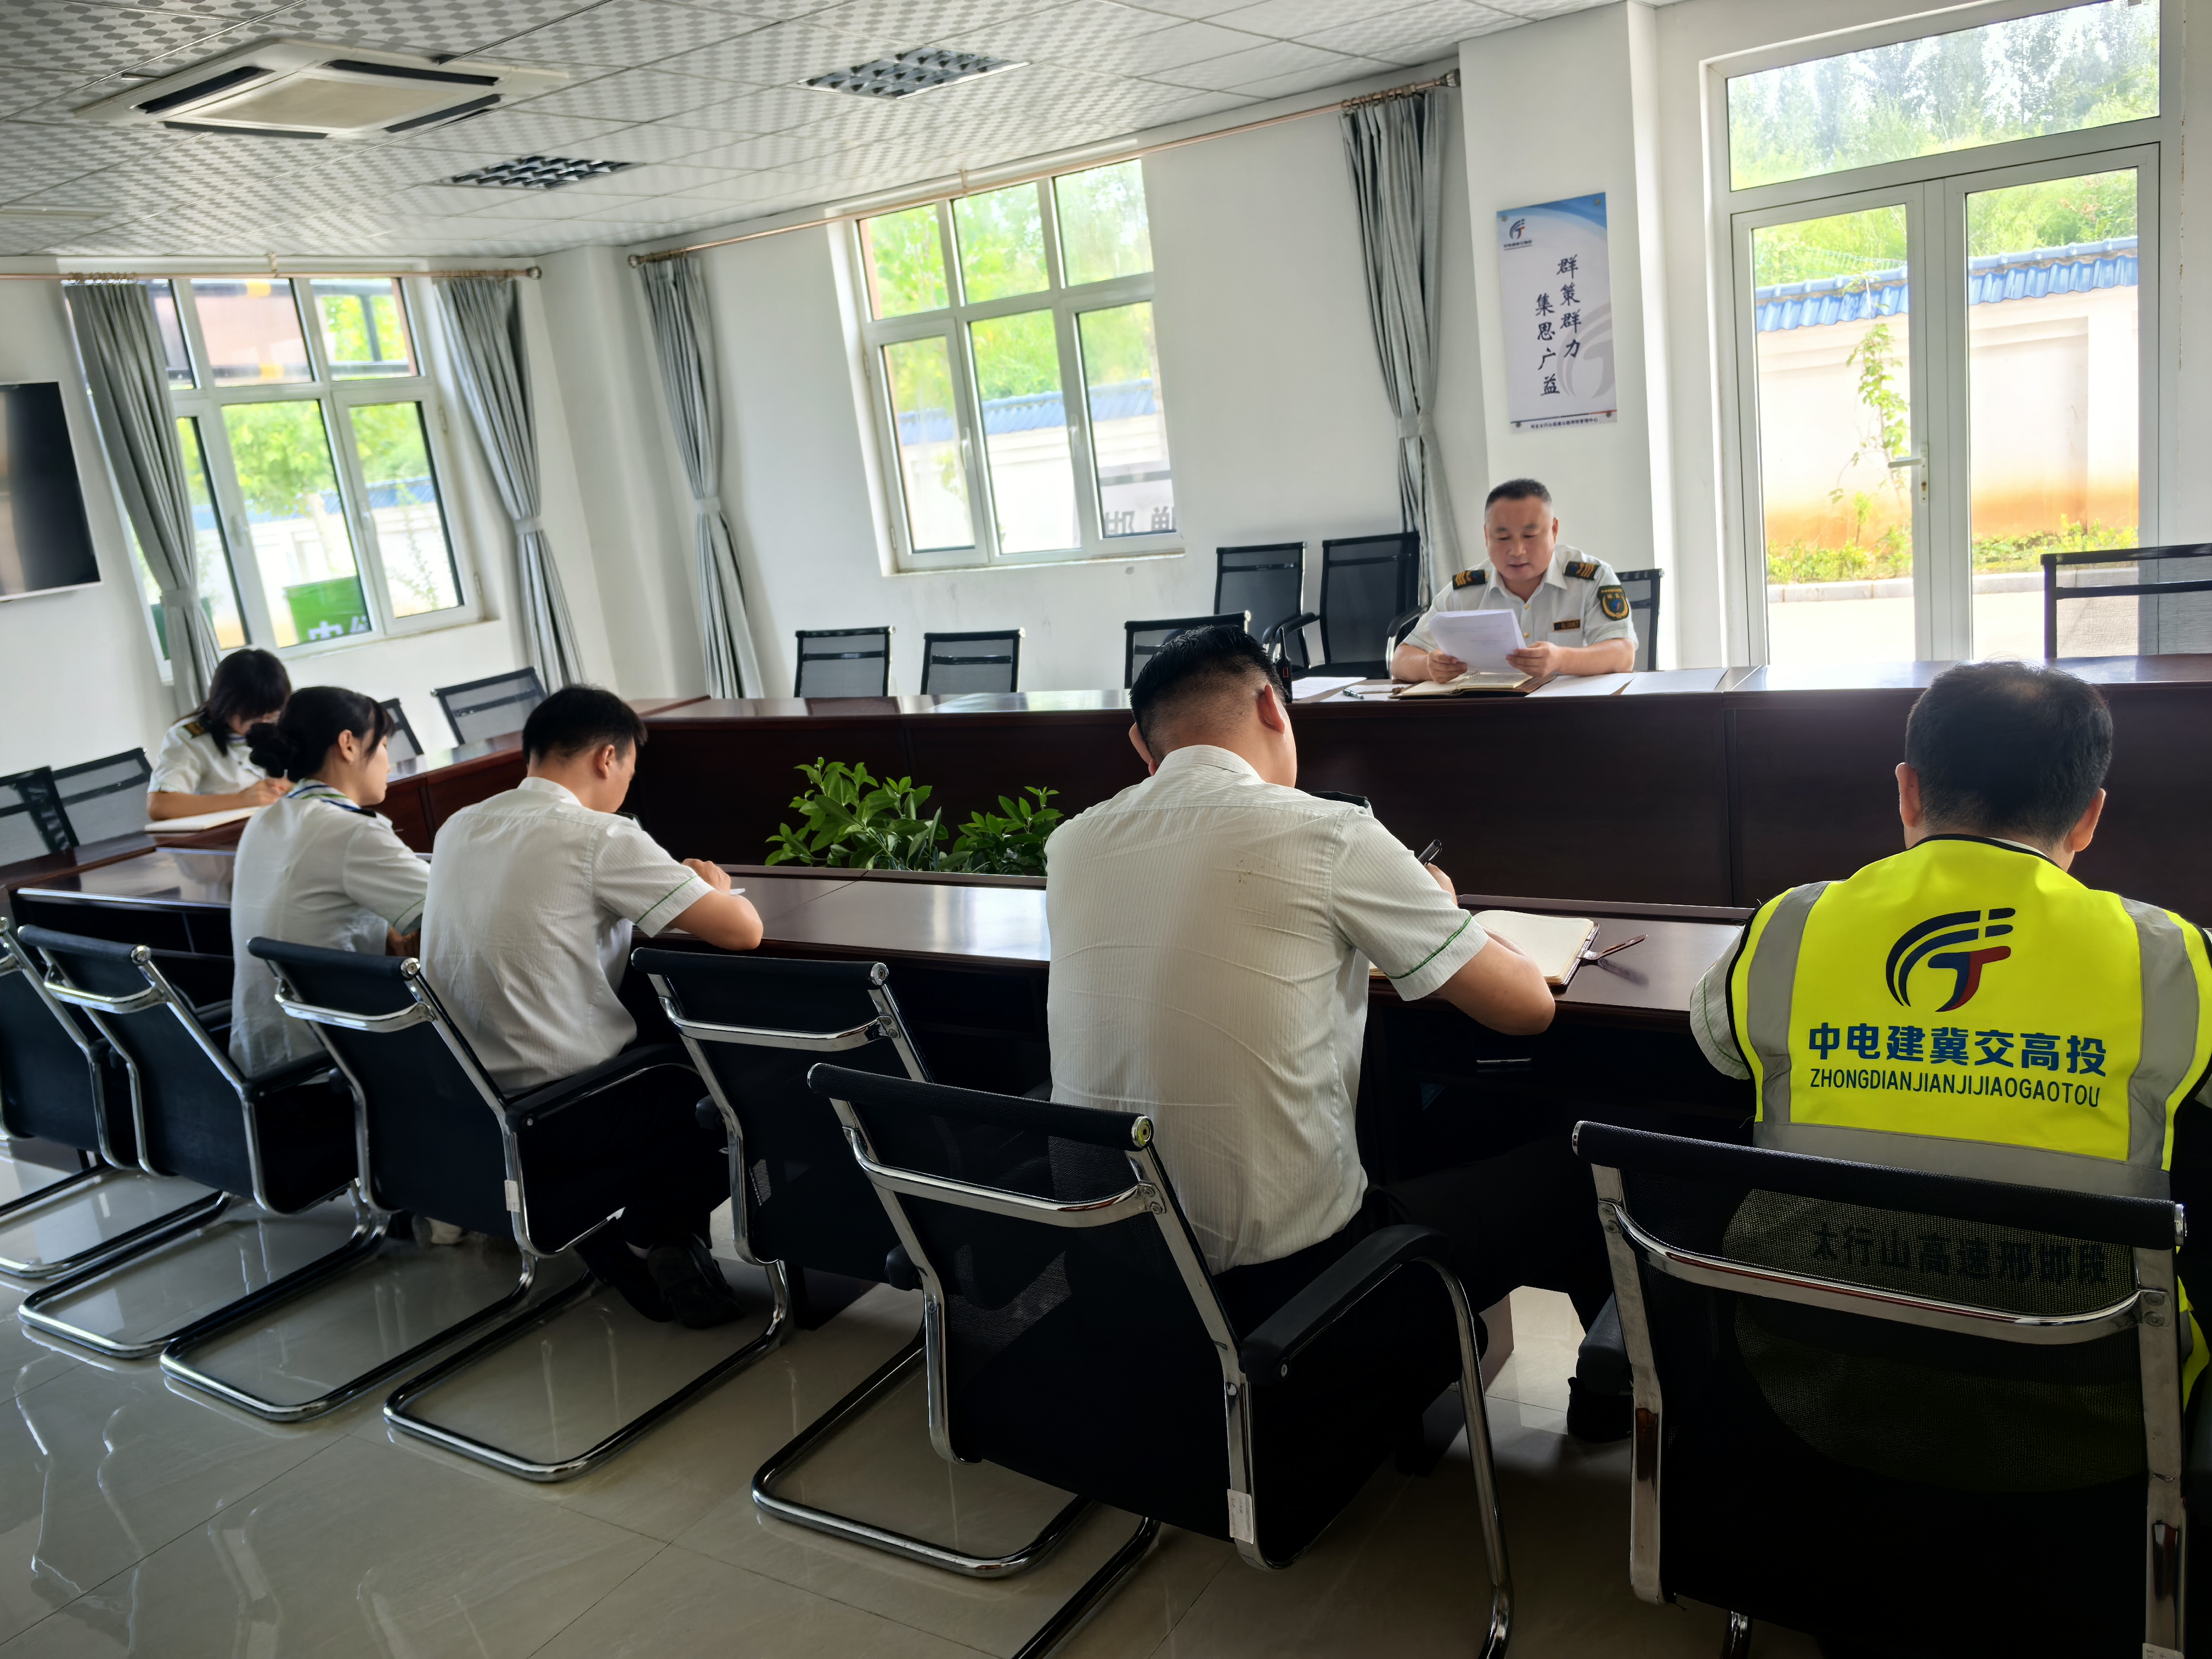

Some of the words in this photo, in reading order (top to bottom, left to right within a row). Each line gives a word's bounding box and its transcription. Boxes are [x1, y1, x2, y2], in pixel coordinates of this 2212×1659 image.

[1556, 254, 1581, 359] 群策群力
[1535, 293, 1560, 397] 集思广益
[1809, 1022, 2107, 1077] 中电建冀交高投
[1810, 1068, 2100, 1108] ZHONGDIANJIANJIJIAOGAOTOU
[1812, 1222, 2107, 1285] 太行山高速邢邯段
